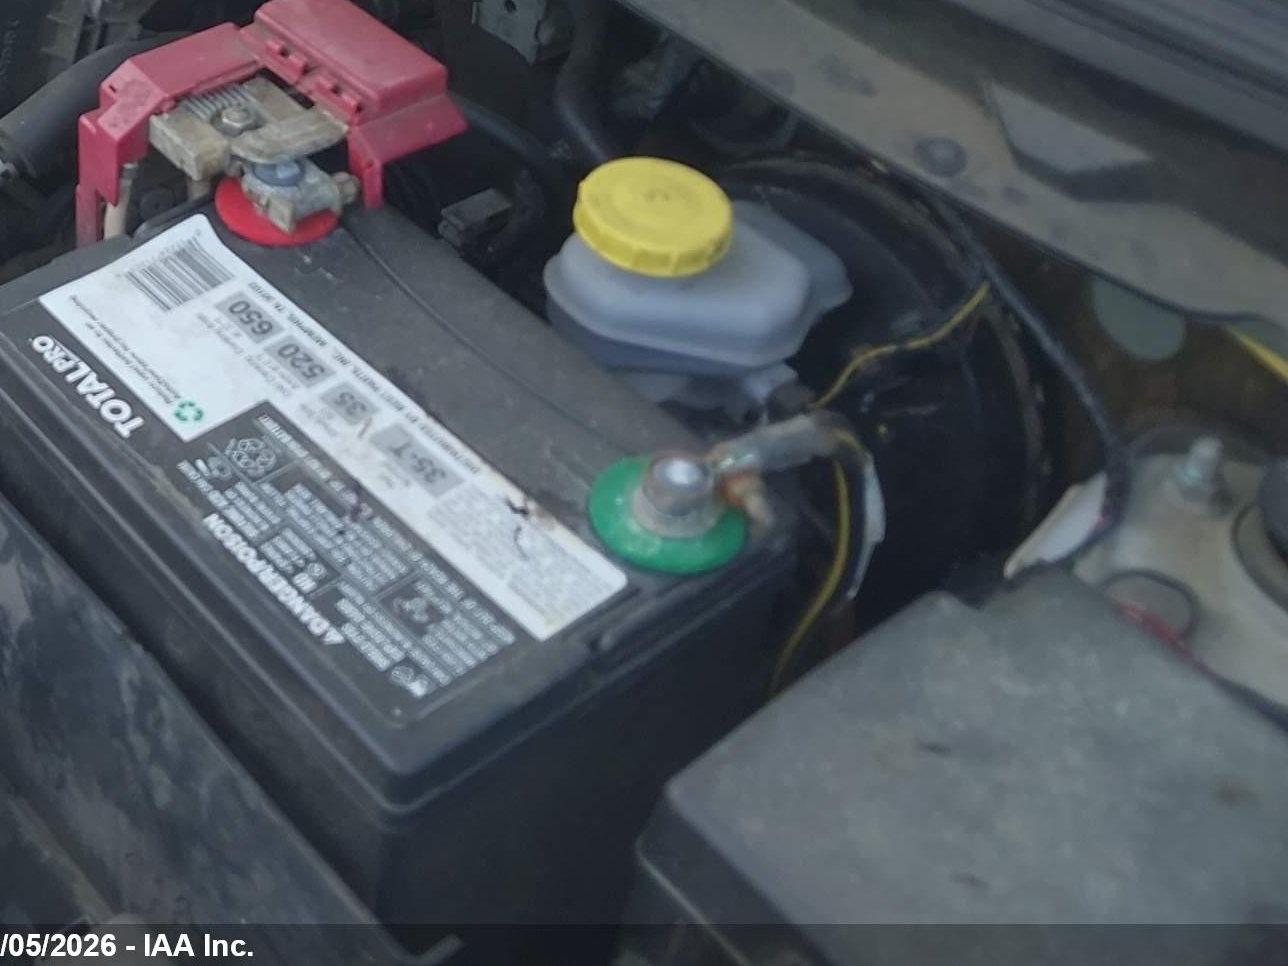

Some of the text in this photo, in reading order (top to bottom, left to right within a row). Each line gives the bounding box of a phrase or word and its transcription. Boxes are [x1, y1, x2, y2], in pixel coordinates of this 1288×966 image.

[227, 298, 276, 337] 650
[278, 342, 324, 380] 520
[27, 334, 146, 438] TOTALPRO
[335, 391, 368, 418] 35
[392, 439, 445, 484] 35-T
[201, 513, 334, 637] DANGER/POISON
